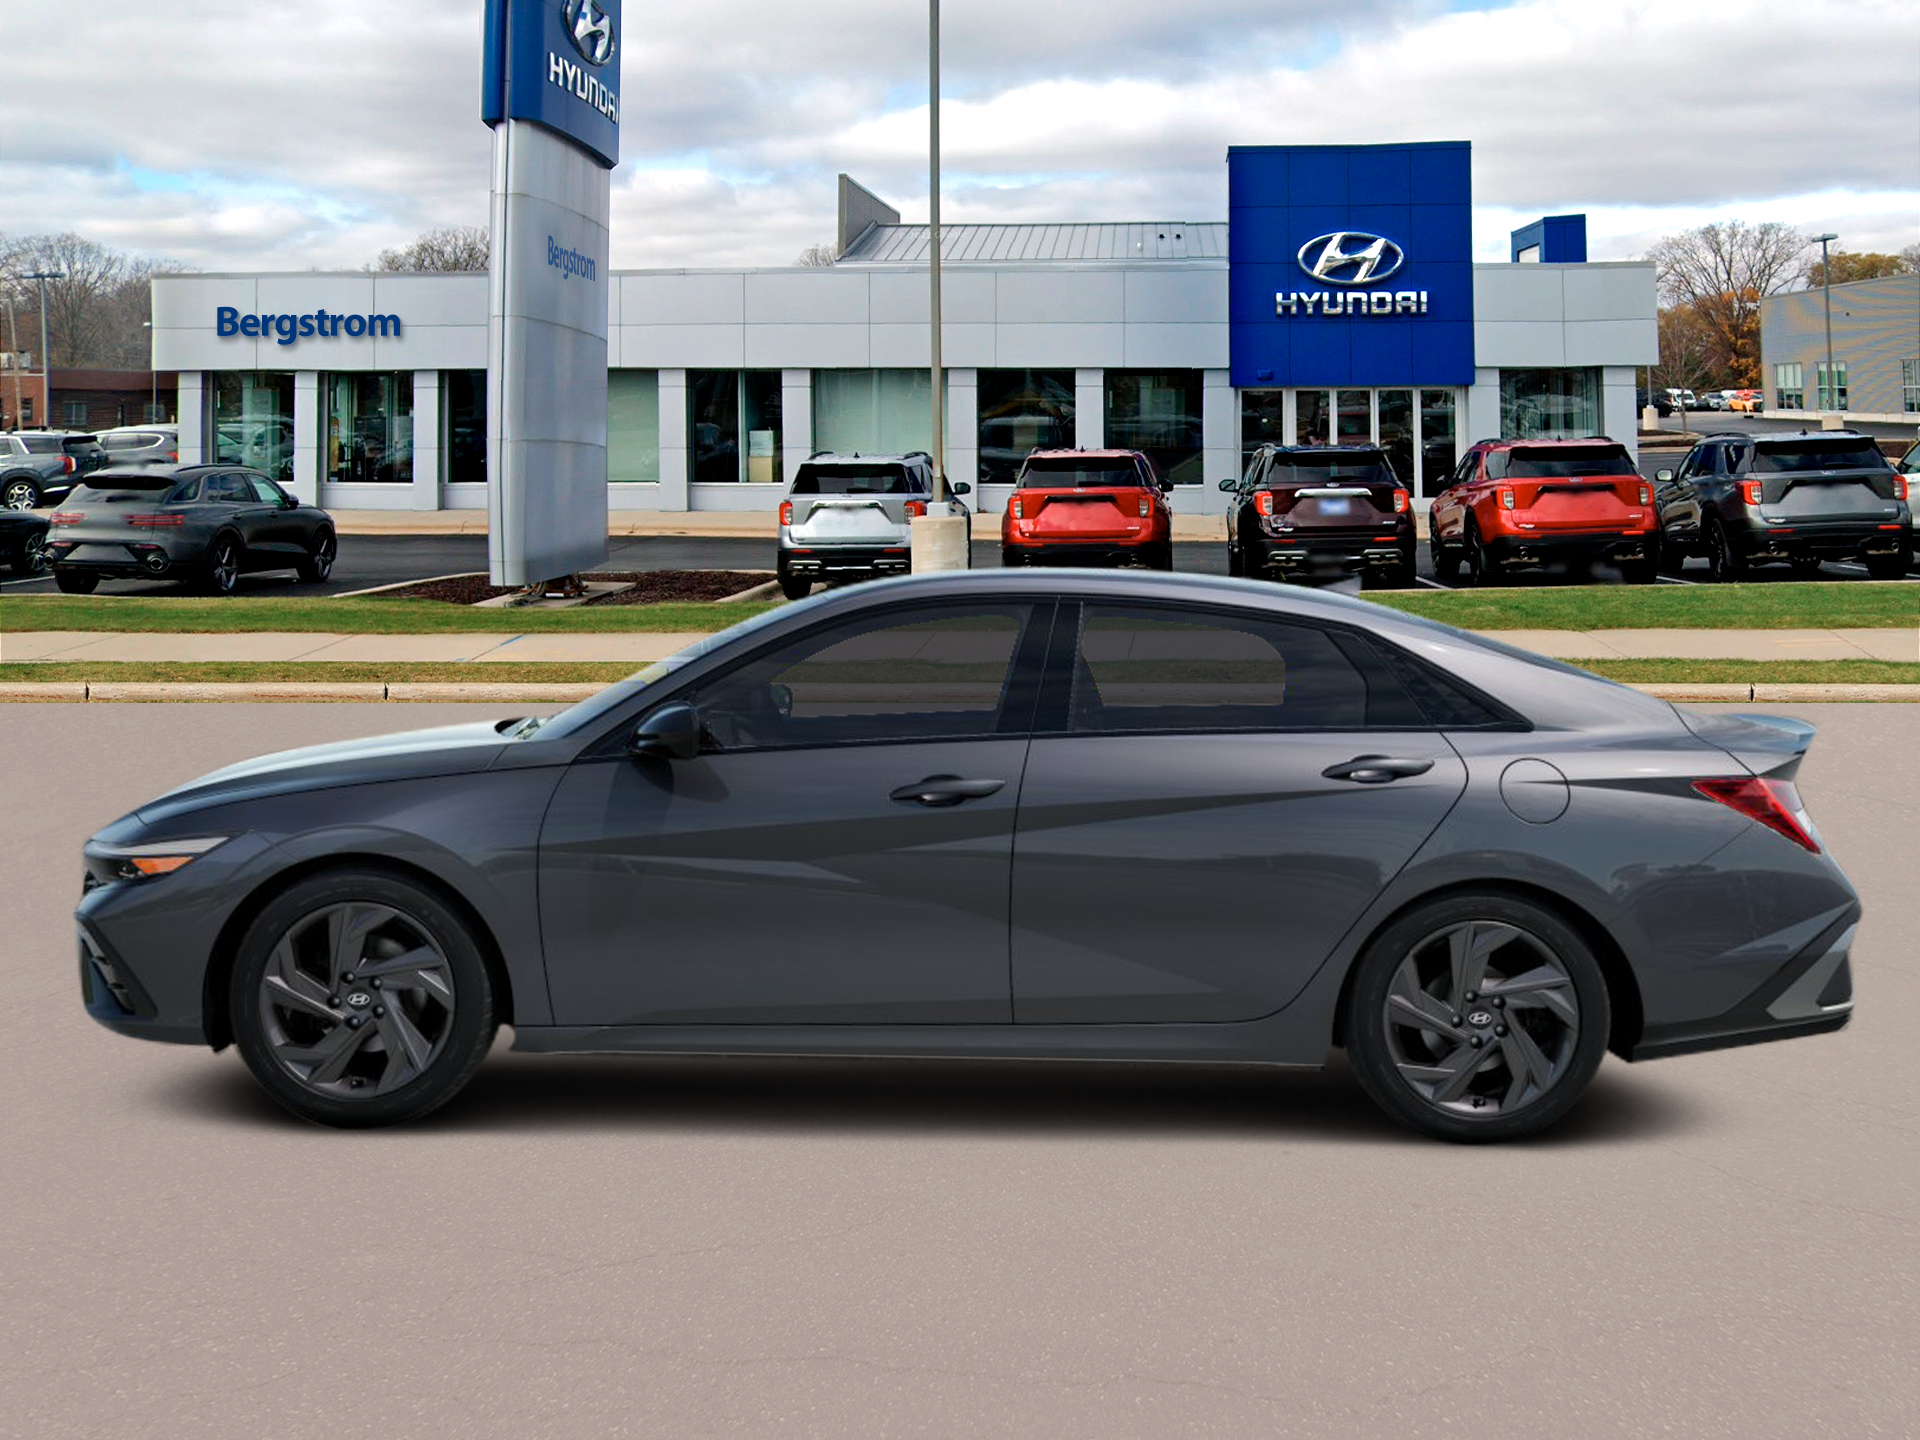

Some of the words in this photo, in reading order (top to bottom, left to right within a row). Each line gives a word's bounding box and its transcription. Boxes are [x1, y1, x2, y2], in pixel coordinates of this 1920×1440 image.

[548, 51, 619, 124] HYUNDAI
[547, 235, 596, 282] Bergstrom
[1275, 291, 1428, 315] HYUNDAI
[216, 306, 402, 346] Bergstrom
